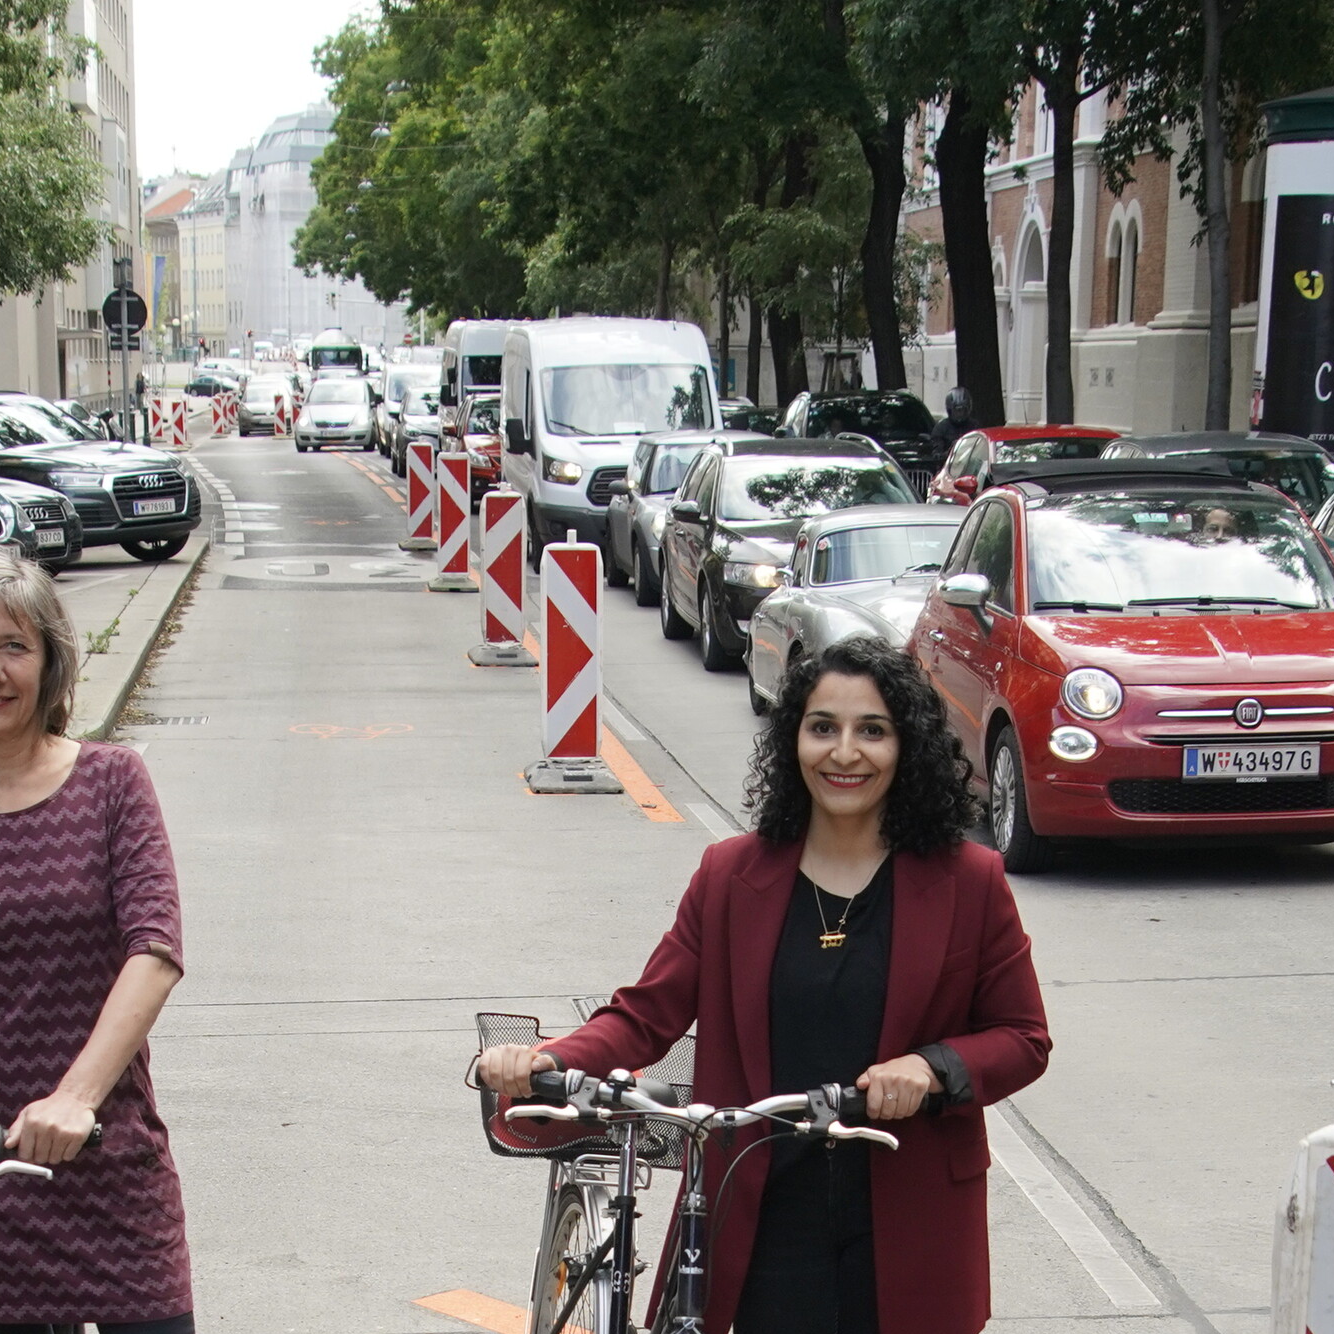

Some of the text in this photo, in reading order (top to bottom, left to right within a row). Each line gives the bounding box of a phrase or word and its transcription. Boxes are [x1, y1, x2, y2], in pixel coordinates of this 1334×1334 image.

[1242, 707, 1257, 720] FIAT
[1202, 752, 1215, 773] W
[1233, 751, 1296, 772] 43497
[1300, 750, 1312, 770] G
